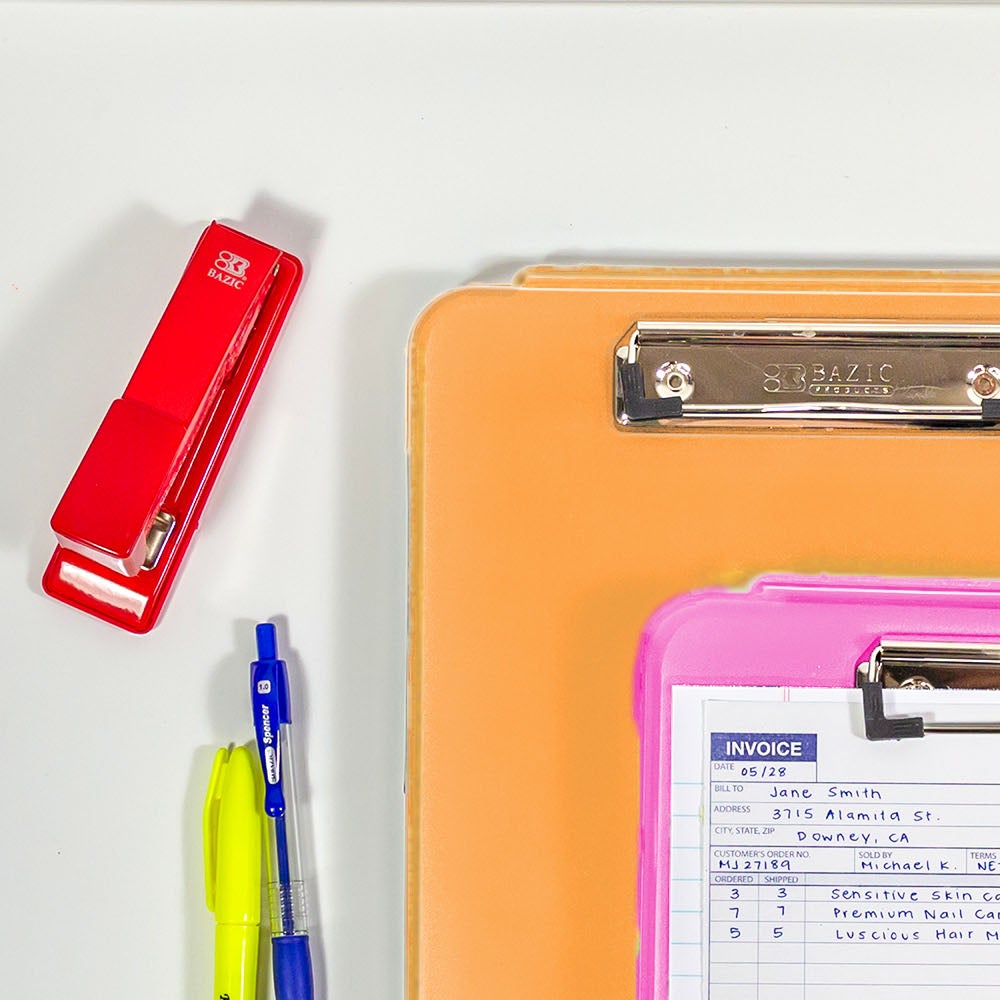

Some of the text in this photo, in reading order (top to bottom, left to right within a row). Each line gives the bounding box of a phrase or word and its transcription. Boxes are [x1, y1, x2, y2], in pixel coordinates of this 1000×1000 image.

[208, 268, 244, 289] BAZIC
[812, 364, 893, 382] BAZIC
[262, 704, 273, 744] Spencer
[727, 742, 801, 757] INVOICE
[741, 766, 786, 777] 05/28
[770, 787, 881, 799] Jane Smith
[772, 808, 941, 821] 3715 Alamita St.
[715, 827, 734, 835] CITY,
[798, 831, 909, 844] Downey, CA
[862, 860, 957, 871] Michael K.
[731, 888, 787, 899] 3 3
[832, 888, 918, 901] Sensitive
[731, 905, 785, 919] 7 7
[834, 908, 914, 920] Premium
[924, 908, 963, 920] Nail
[731, 927, 783, 938] 5 5
[836, 929, 919, 941] Luscious
[936, 930, 973, 941] Hair
